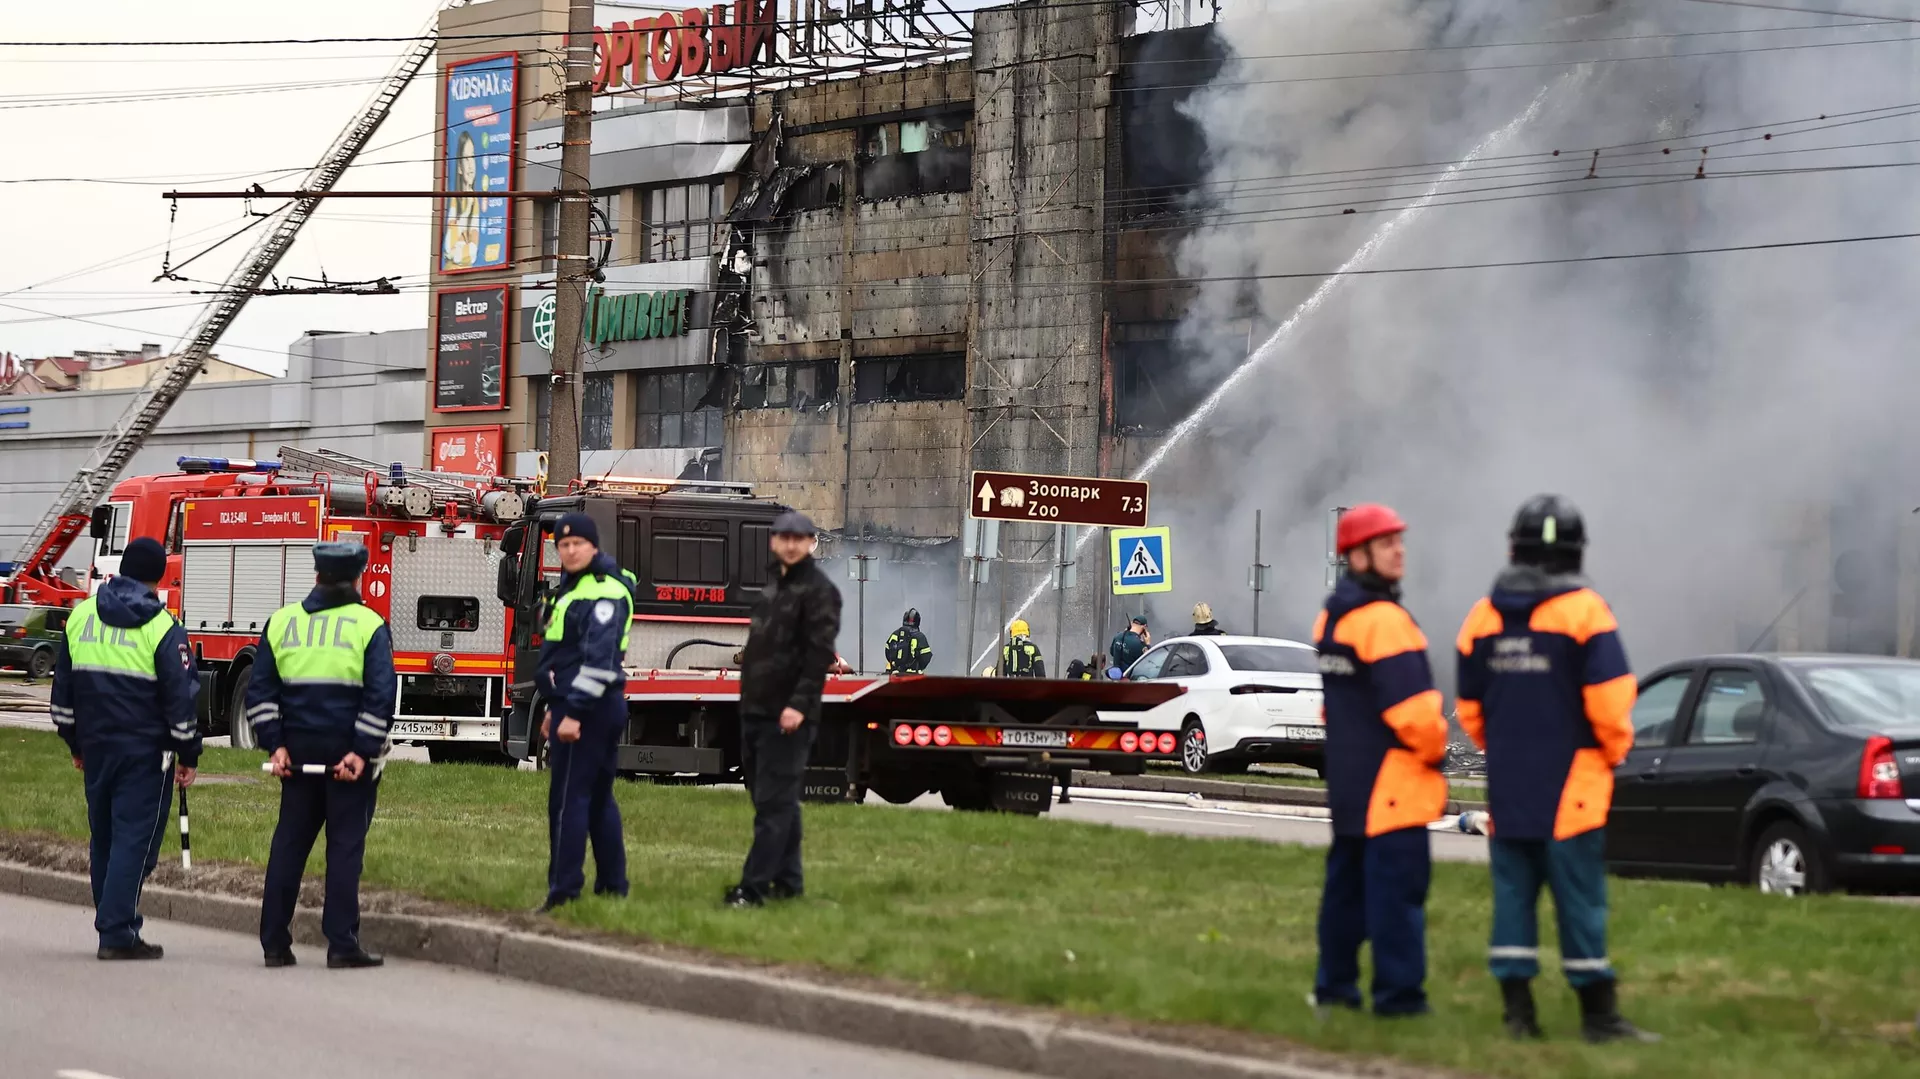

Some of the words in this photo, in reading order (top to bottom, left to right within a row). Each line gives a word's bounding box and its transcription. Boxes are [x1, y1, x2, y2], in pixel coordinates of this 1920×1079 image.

[563, 0, 777, 93] ОРГОВЫЙ
[1028, 480, 1100, 502] Зоопарк
[1028, 501, 1059, 518] Zoo
[1121, 496, 1143, 514] 7,3
[668, 519, 711, 531] IVECO
[674, 587, 725, 603] 90-77-88
[280, 614, 358, 650] ДПС
[638, 751, 654, 764] GALS
[804, 785, 840, 795] IVECO
[1005, 790, 1040, 802] IVECO
